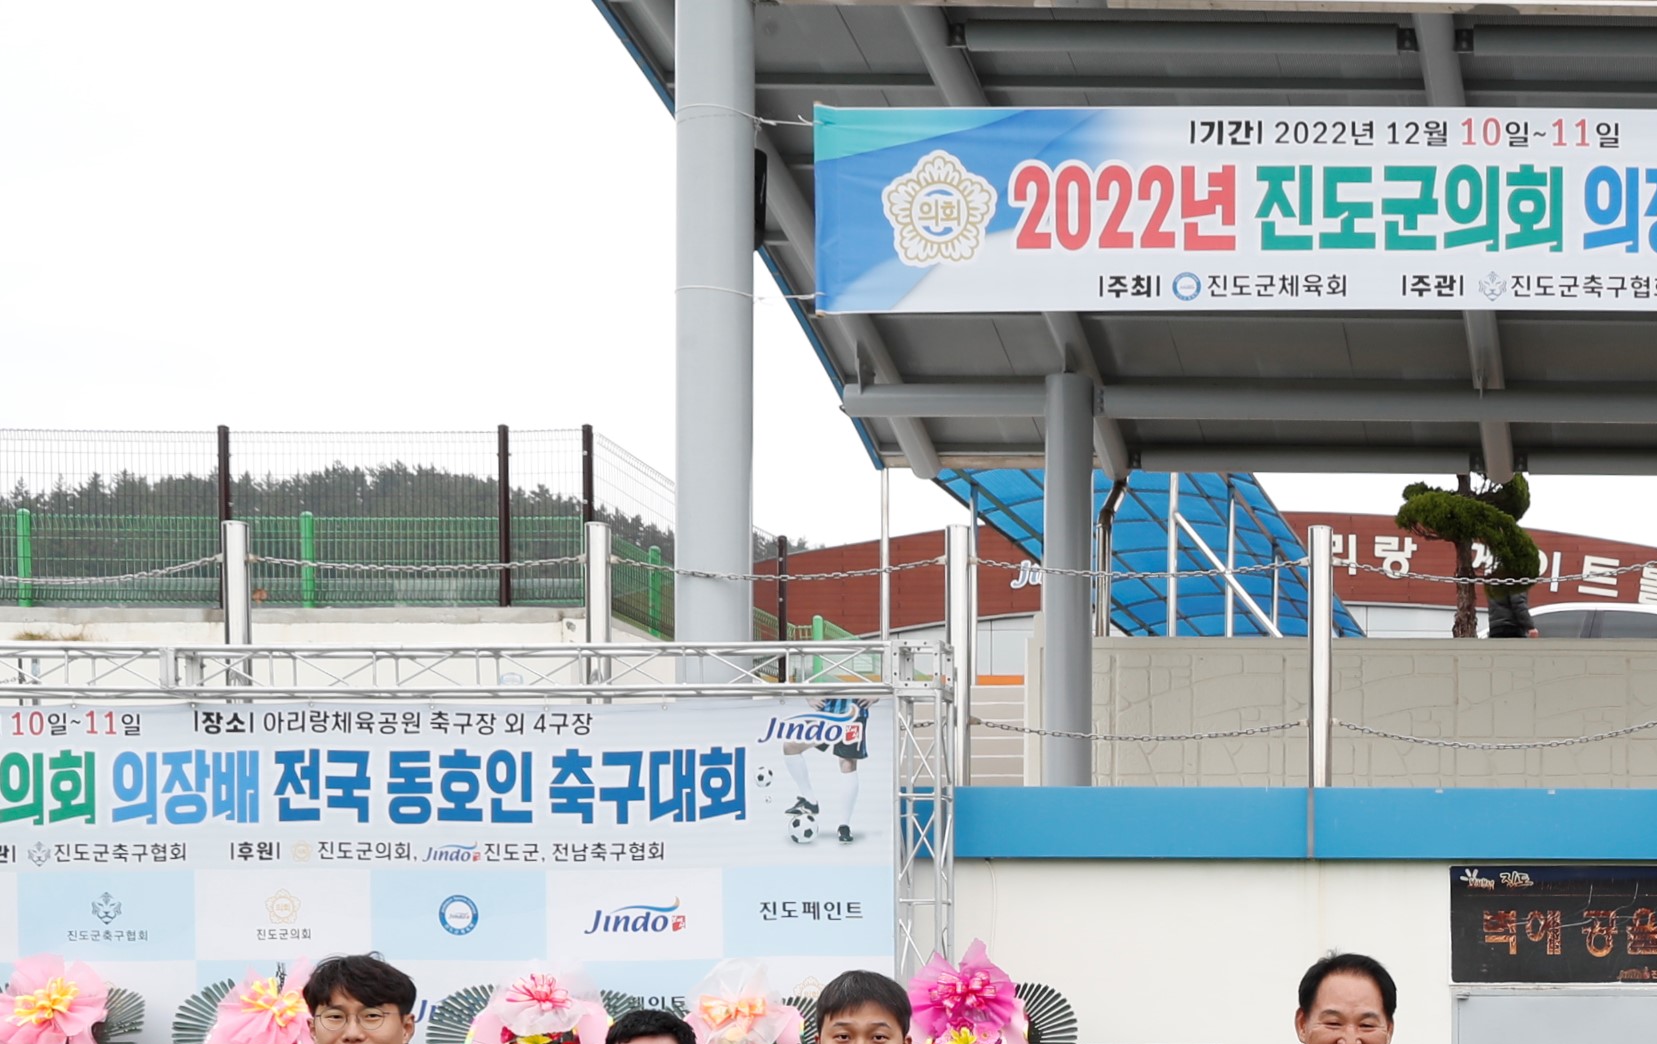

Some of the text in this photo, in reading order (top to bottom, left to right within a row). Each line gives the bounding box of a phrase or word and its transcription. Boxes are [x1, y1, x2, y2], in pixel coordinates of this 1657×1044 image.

[1273, 121, 1376, 148] 2022년
[1386, 122, 1449, 148] 12월
[1460, 117, 1622, 149] 10일~11일
[918, 199, 961, 228] 의회
[1012, 163, 1237, 252] 2022년
[1254, 163, 1565, 254] 진도군의회
[1207, 272, 1349, 300] 진도군체육회
[1331, 534, 1418, 579] 리랑
[262, 710, 422, 736] 아리랑체육공원
[429, 711, 497, 736] 축구장
[503, 712, 525, 735] 외
[533, 712, 593, 736] 4구장
[757, 717, 843, 744] Jindo
[111, 749, 260, 825] 의장배
[273, 748, 371, 824] 전국
[386, 748, 533, 825] 동호인
[549, 746, 747, 825] 축구대회
[53, 842, 187, 863] 진도군축구협회
[551, 841, 665, 863] 전남축구협회
[584, 908, 669, 935] Jindo
[759, 901, 863, 921] 진도페인트
[67, 929, 149, 943] 진도군축구협회
[256, 928, 312, 941] 진도군의회
